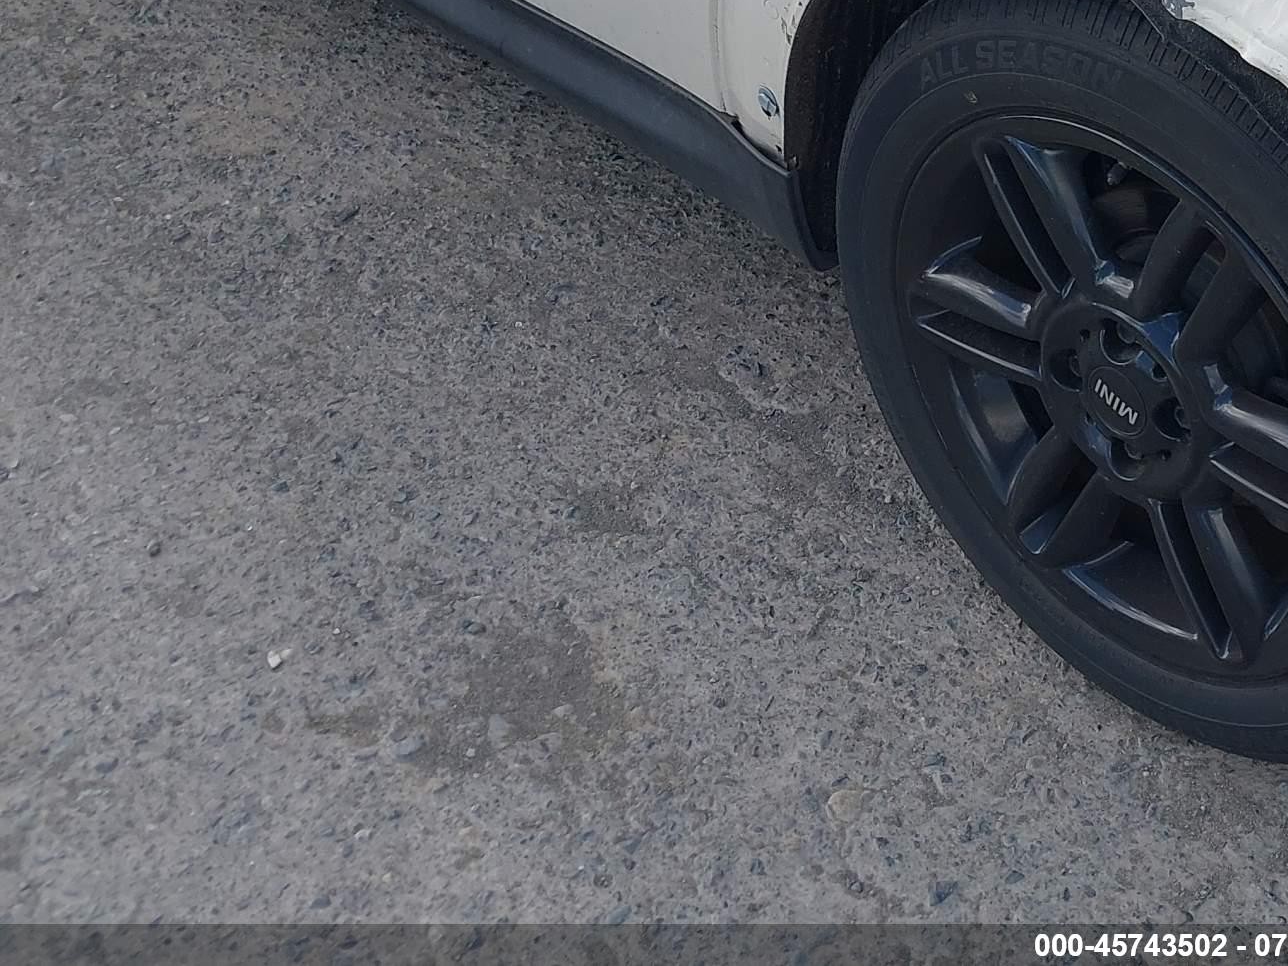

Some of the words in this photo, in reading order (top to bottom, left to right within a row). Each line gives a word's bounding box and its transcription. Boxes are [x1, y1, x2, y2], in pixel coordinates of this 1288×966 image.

[919, 41, 969, 91] ALL
[975, 39, 1124, 90] SEASON
[1094, 378, 1139, 425] MINI
